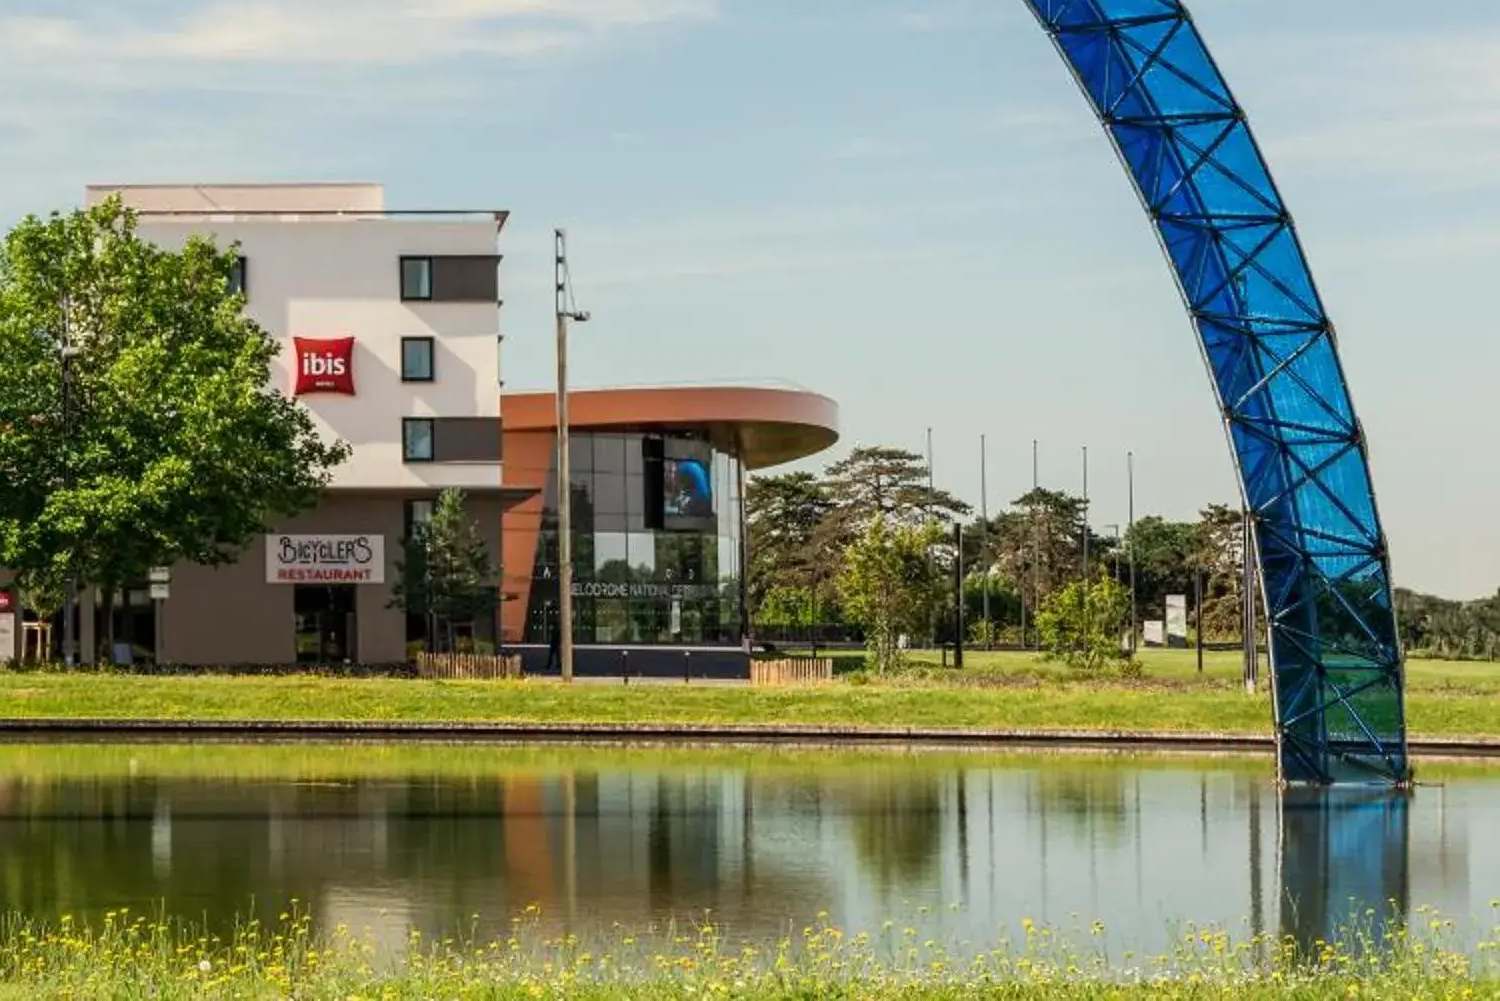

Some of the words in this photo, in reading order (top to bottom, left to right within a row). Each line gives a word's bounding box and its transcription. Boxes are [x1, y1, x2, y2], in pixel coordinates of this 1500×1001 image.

[303, 352, 345, 375] ibis
[277, 569, 372, 580] RESTAURANT
[571, 582, 629, 596] ELODROME
